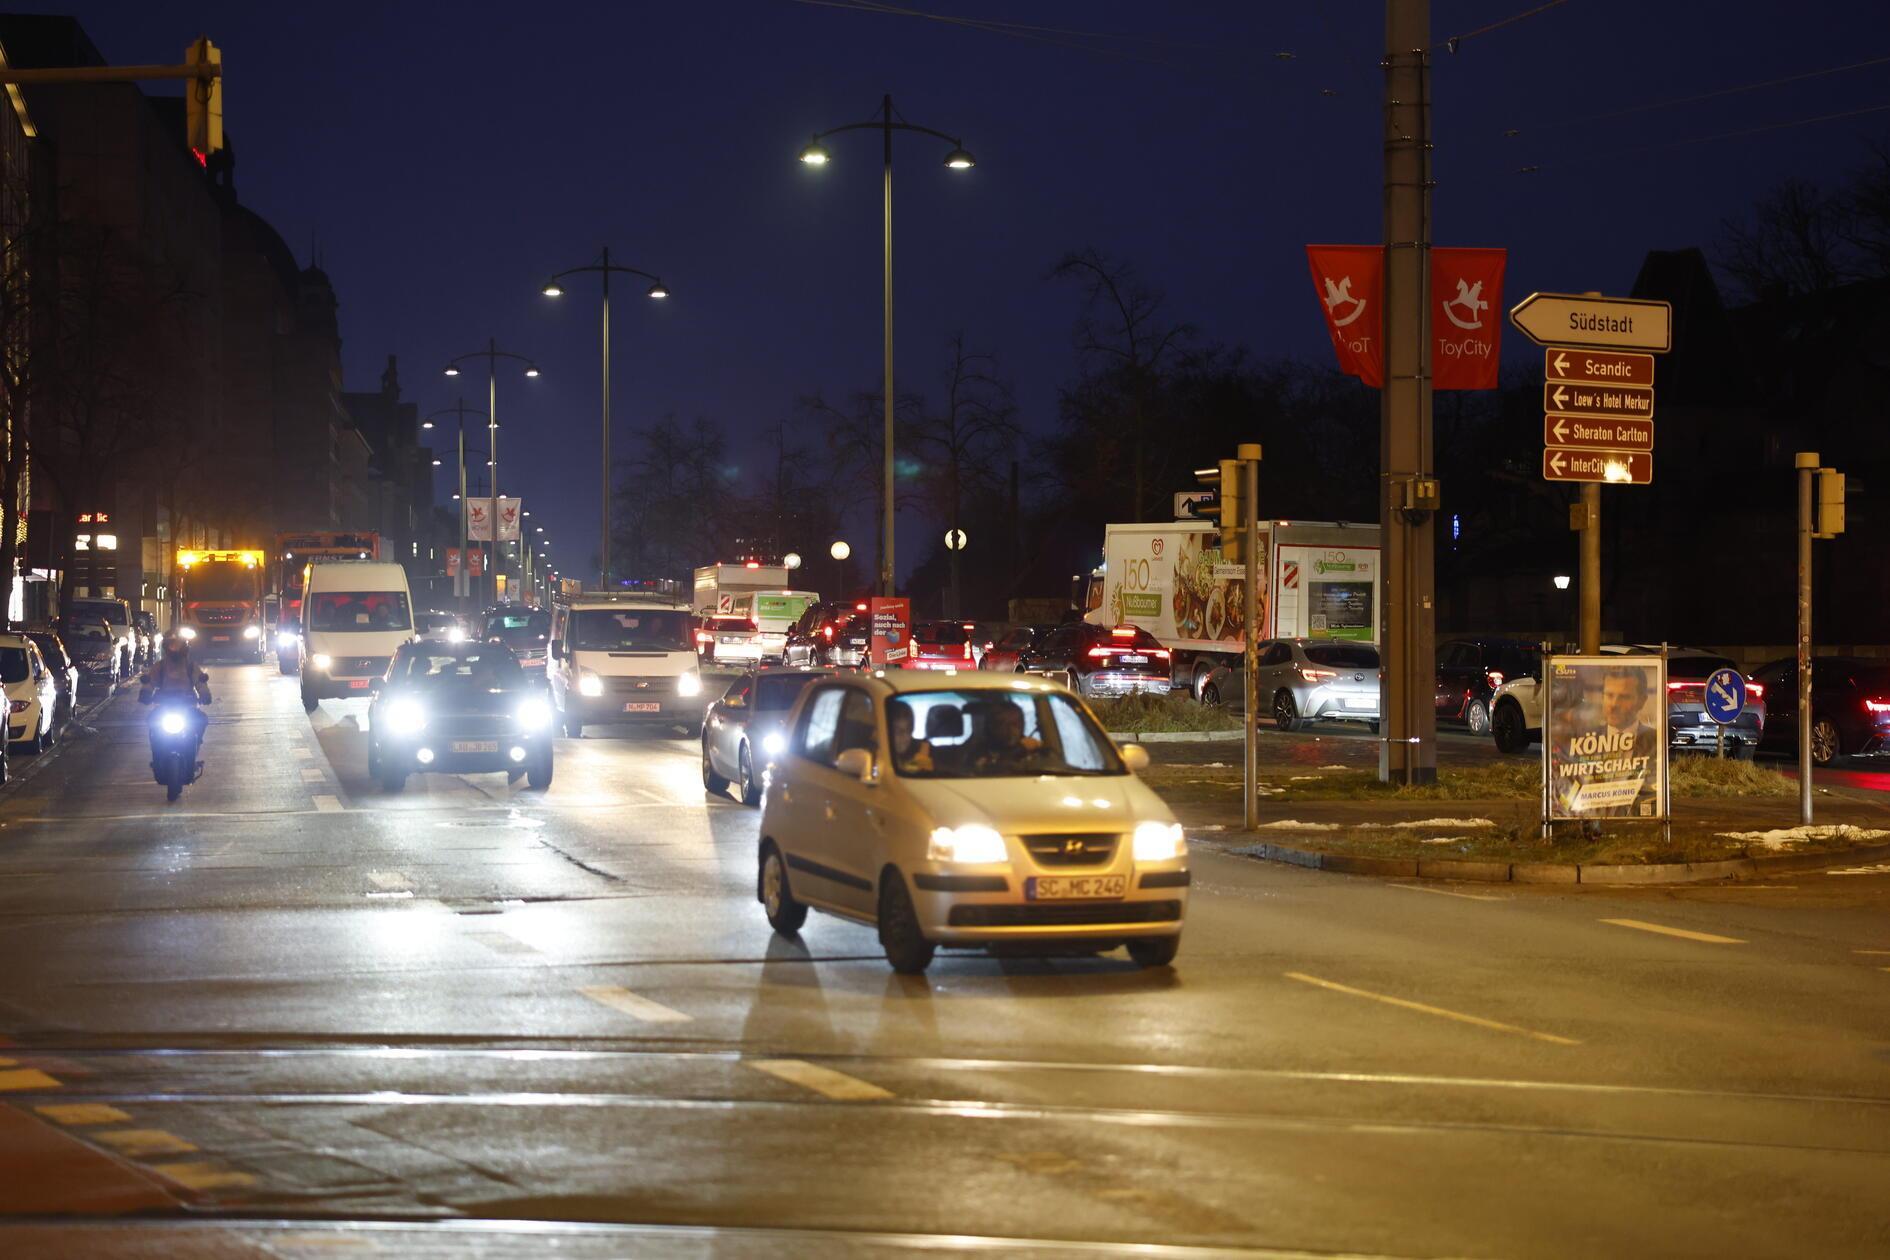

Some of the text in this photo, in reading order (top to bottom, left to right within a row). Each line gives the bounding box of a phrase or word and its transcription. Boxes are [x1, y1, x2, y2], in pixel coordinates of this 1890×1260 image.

[1569, 312, 1633, 333] Südstadt
[1439, 338, 1492, 359] ToyCity
[1585, 359, 1632, 377] Scandic
[1603, 392, 1622, 409] Hotel
[1624, 394, 1650, 410] Merkur
[1573, 423, 1648, 442] Sheraton Carlton
[1323, 551, 1346, 563] 150
[1123, 558, 1150, 591] 150
[874, 614, 897, 622] Sozial,
[1569, 732, 1634, 757] KÖNIG
[1559, 756, 1650, 777] WIRTSCHAFT
[1580, 790, 1611, 800] MARCUS
[1039, 880, 1122, 896] SC MC 246
